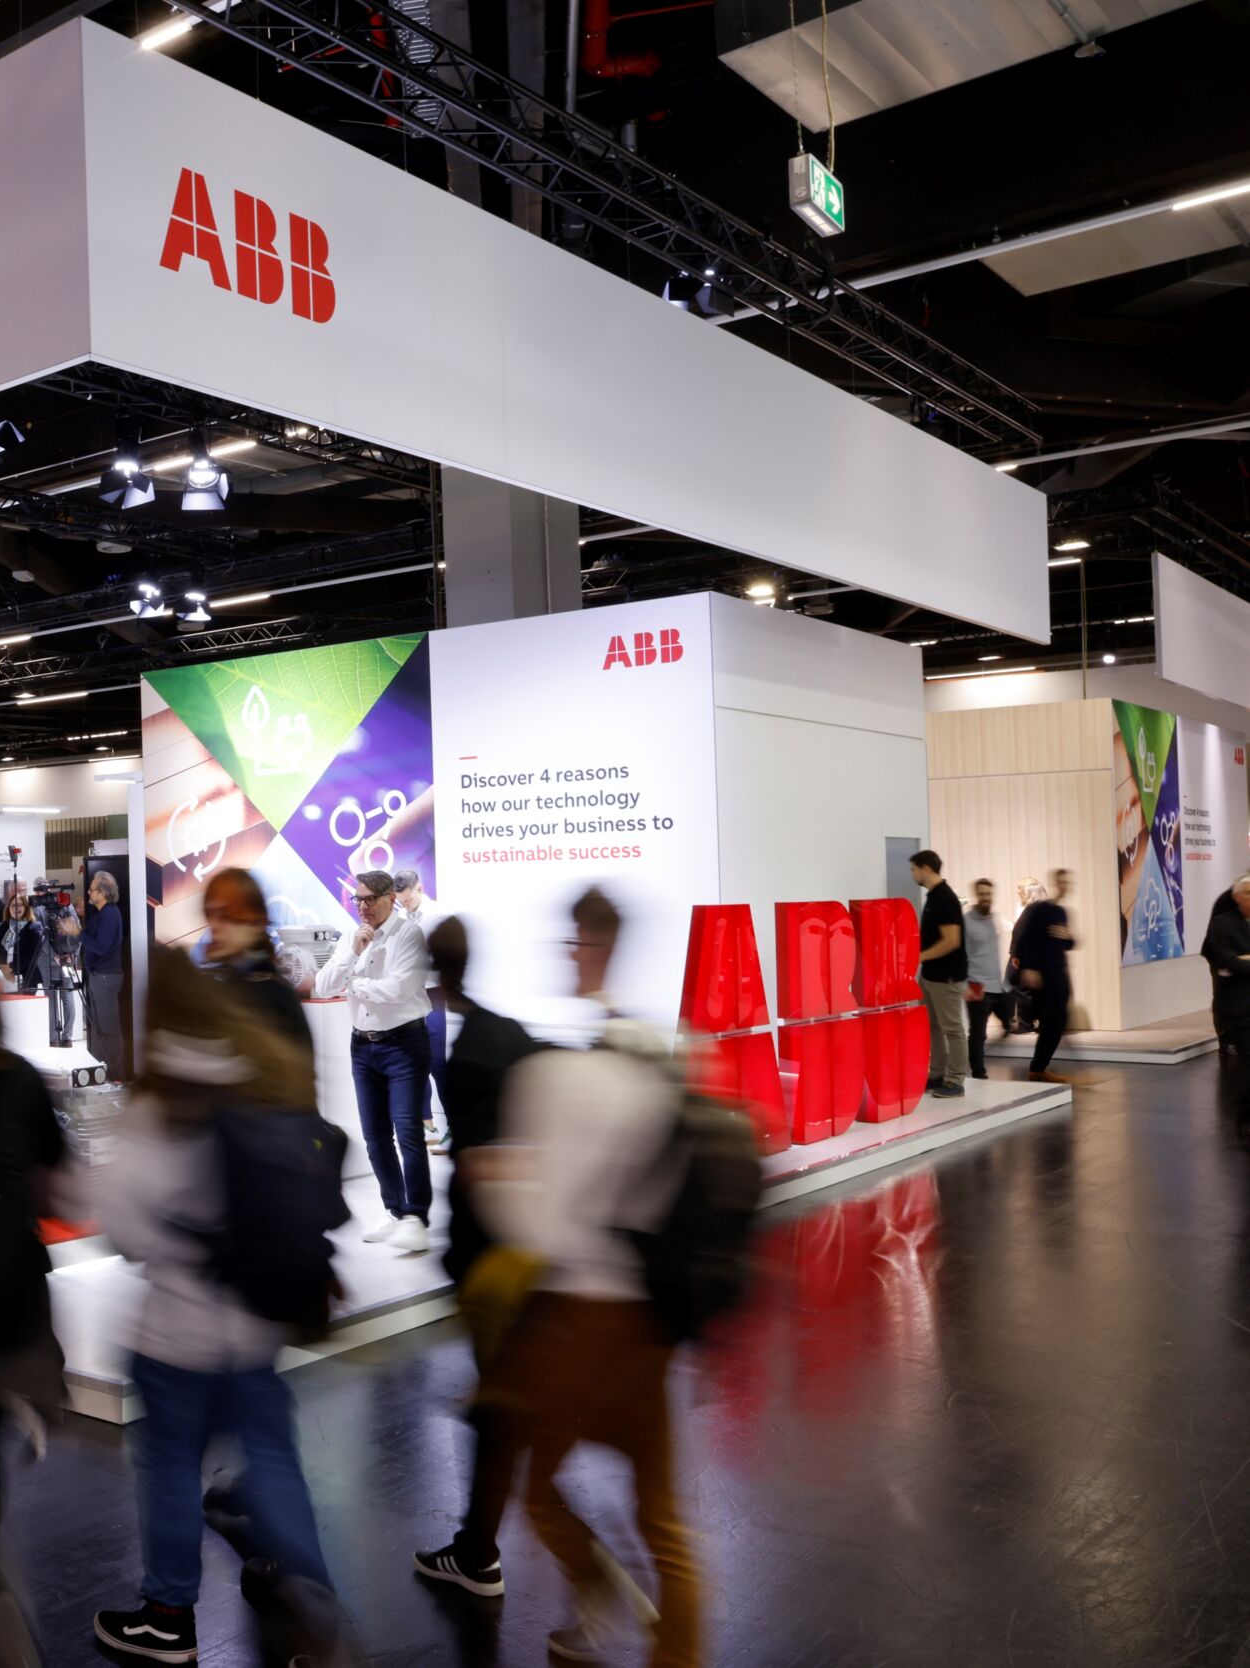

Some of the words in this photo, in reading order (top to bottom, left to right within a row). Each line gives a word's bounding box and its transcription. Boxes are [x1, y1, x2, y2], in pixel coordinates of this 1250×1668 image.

[159, 166, 336, 324] ABB
[603, 628, 684, 671] ABB
[460, 772, 535, 789] Discover
[539, 768, 551, 783] 4
[555, 765, 630, 783] reasons
[460, 798, 497, 814] how
[501, 798, 531, 811] our
[535, 789, 641, 810] technology
[461, 822, 514, 839] drives
[519, 822, 559, 841] your
[563, 815, 647, 834] business
[651, 814, 674, 830] to
[462, 844, 563, 864] sustainable
[568, 844, 642, 860] success
[671, 897, 932, 1157] ABB
